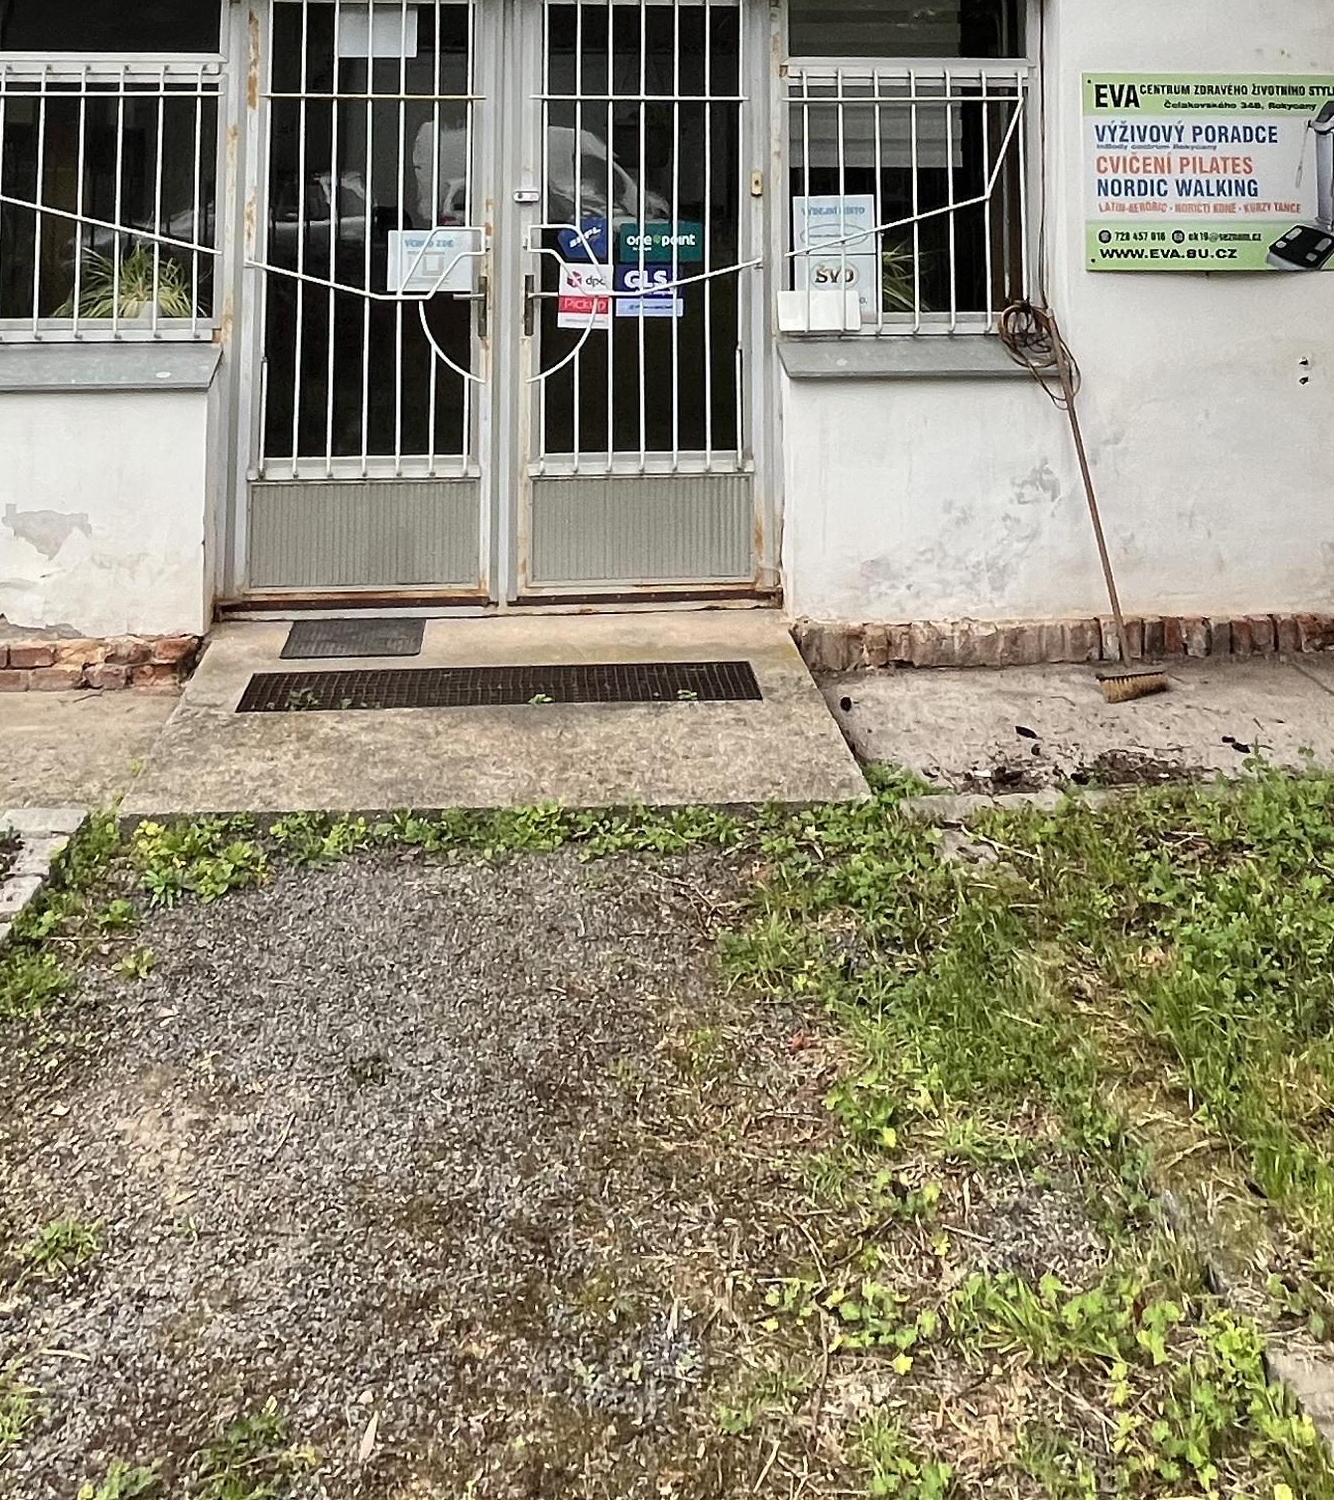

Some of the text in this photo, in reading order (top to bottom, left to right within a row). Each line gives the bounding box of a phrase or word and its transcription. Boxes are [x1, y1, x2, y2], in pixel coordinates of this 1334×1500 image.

[1094, 83, 1140, 108] EVA
[1140, 84, 1190, 95] CENTRUM
[1194, 83, 1248, 95] ZDRAVÉHO
[1094, 120, 1278, 143] VÝŽIVOVÝ PORADCE
[1096, 152, 1253, 174] CVIČENÍ PILATES
[1097, 178, 1258, 197] NORDIC WALKING
[623, 270, 668, 288] GLS
